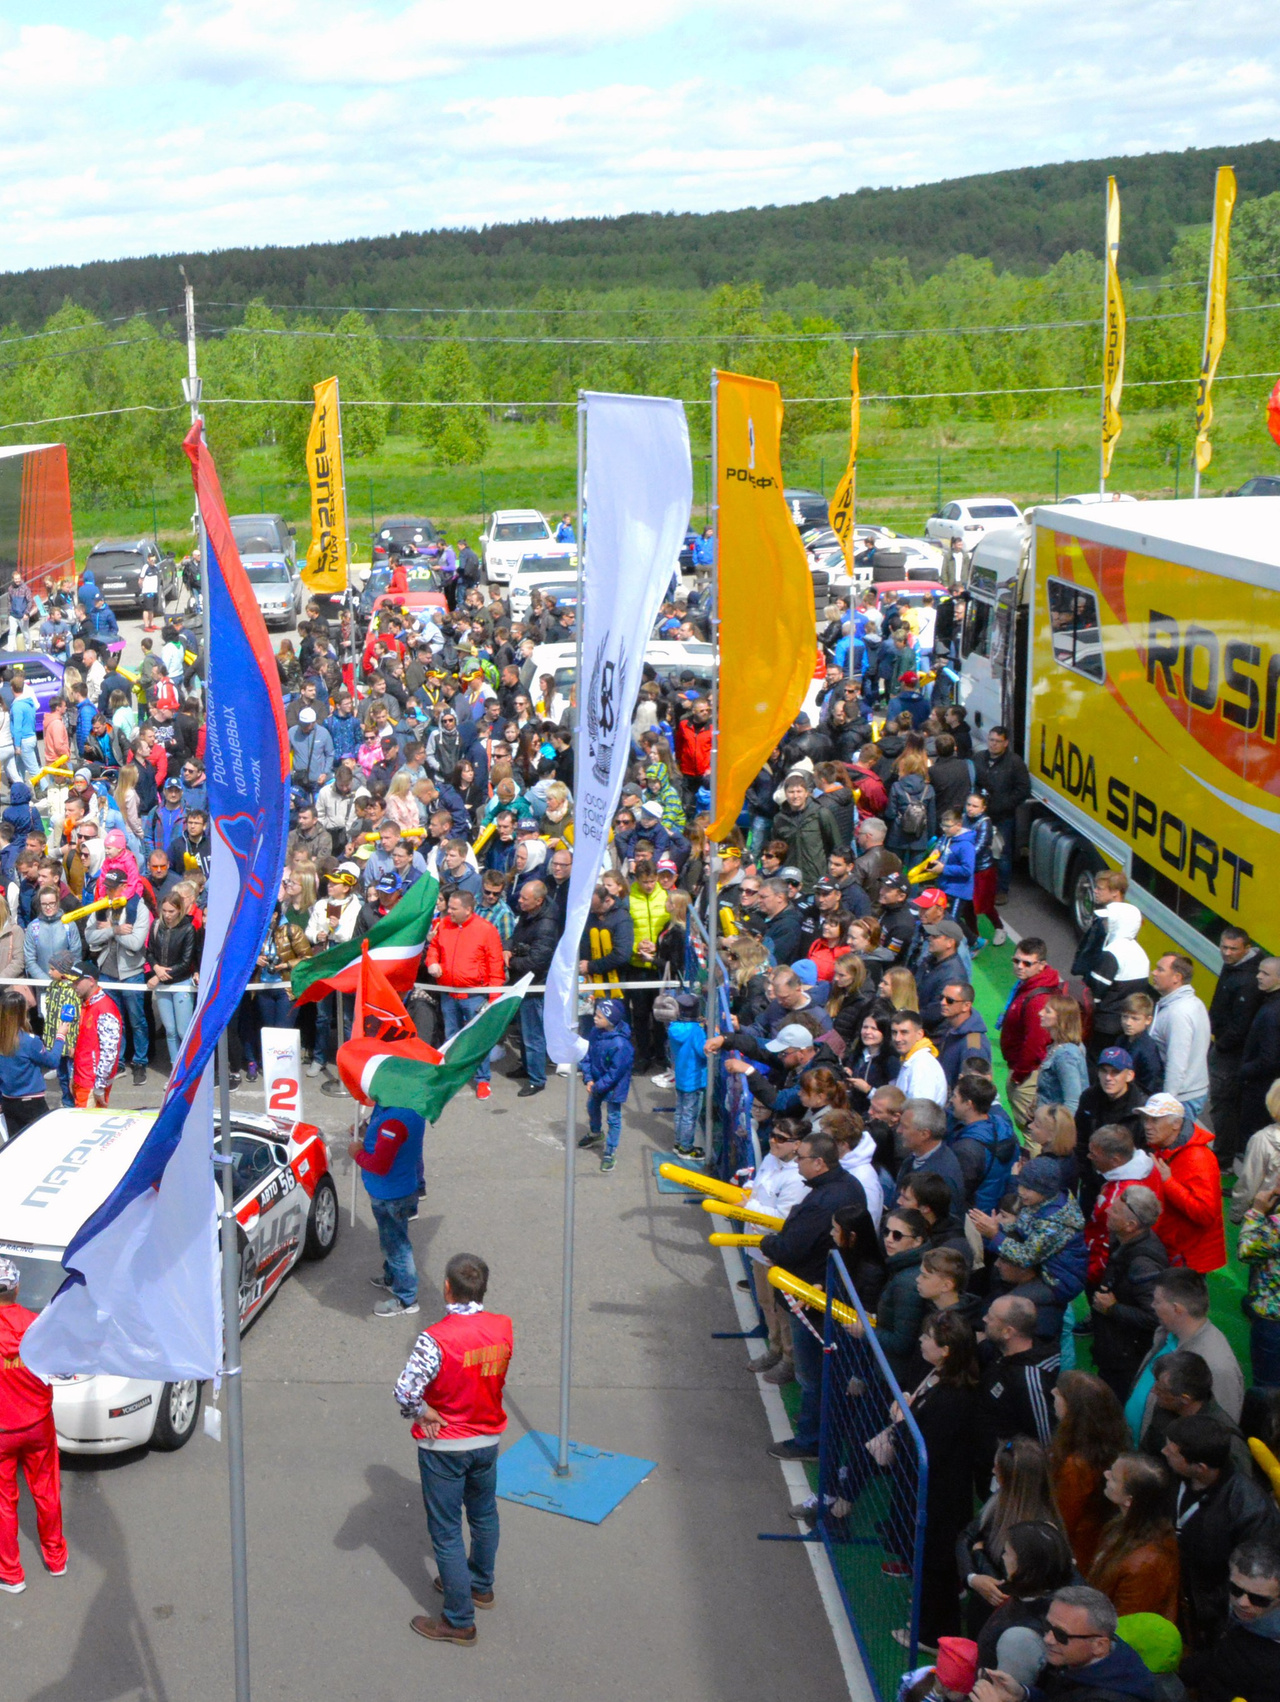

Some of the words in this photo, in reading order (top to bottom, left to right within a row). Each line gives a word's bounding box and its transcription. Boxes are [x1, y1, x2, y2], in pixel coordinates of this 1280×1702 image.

[223, 704, 247, 796] кольцевых
[1041, 724, 1099, 812] LADA
[1107, 776, 1254, 911] SPORT
[269, 1078, 298, 1111] 2
[261, 1181, 279, 1207] АВТО
[278, 1167, 295, 1196] 56
[6, 1243, 34, 1254] RACING
[121, 1396, 152, 1416] YOKOHAMA
